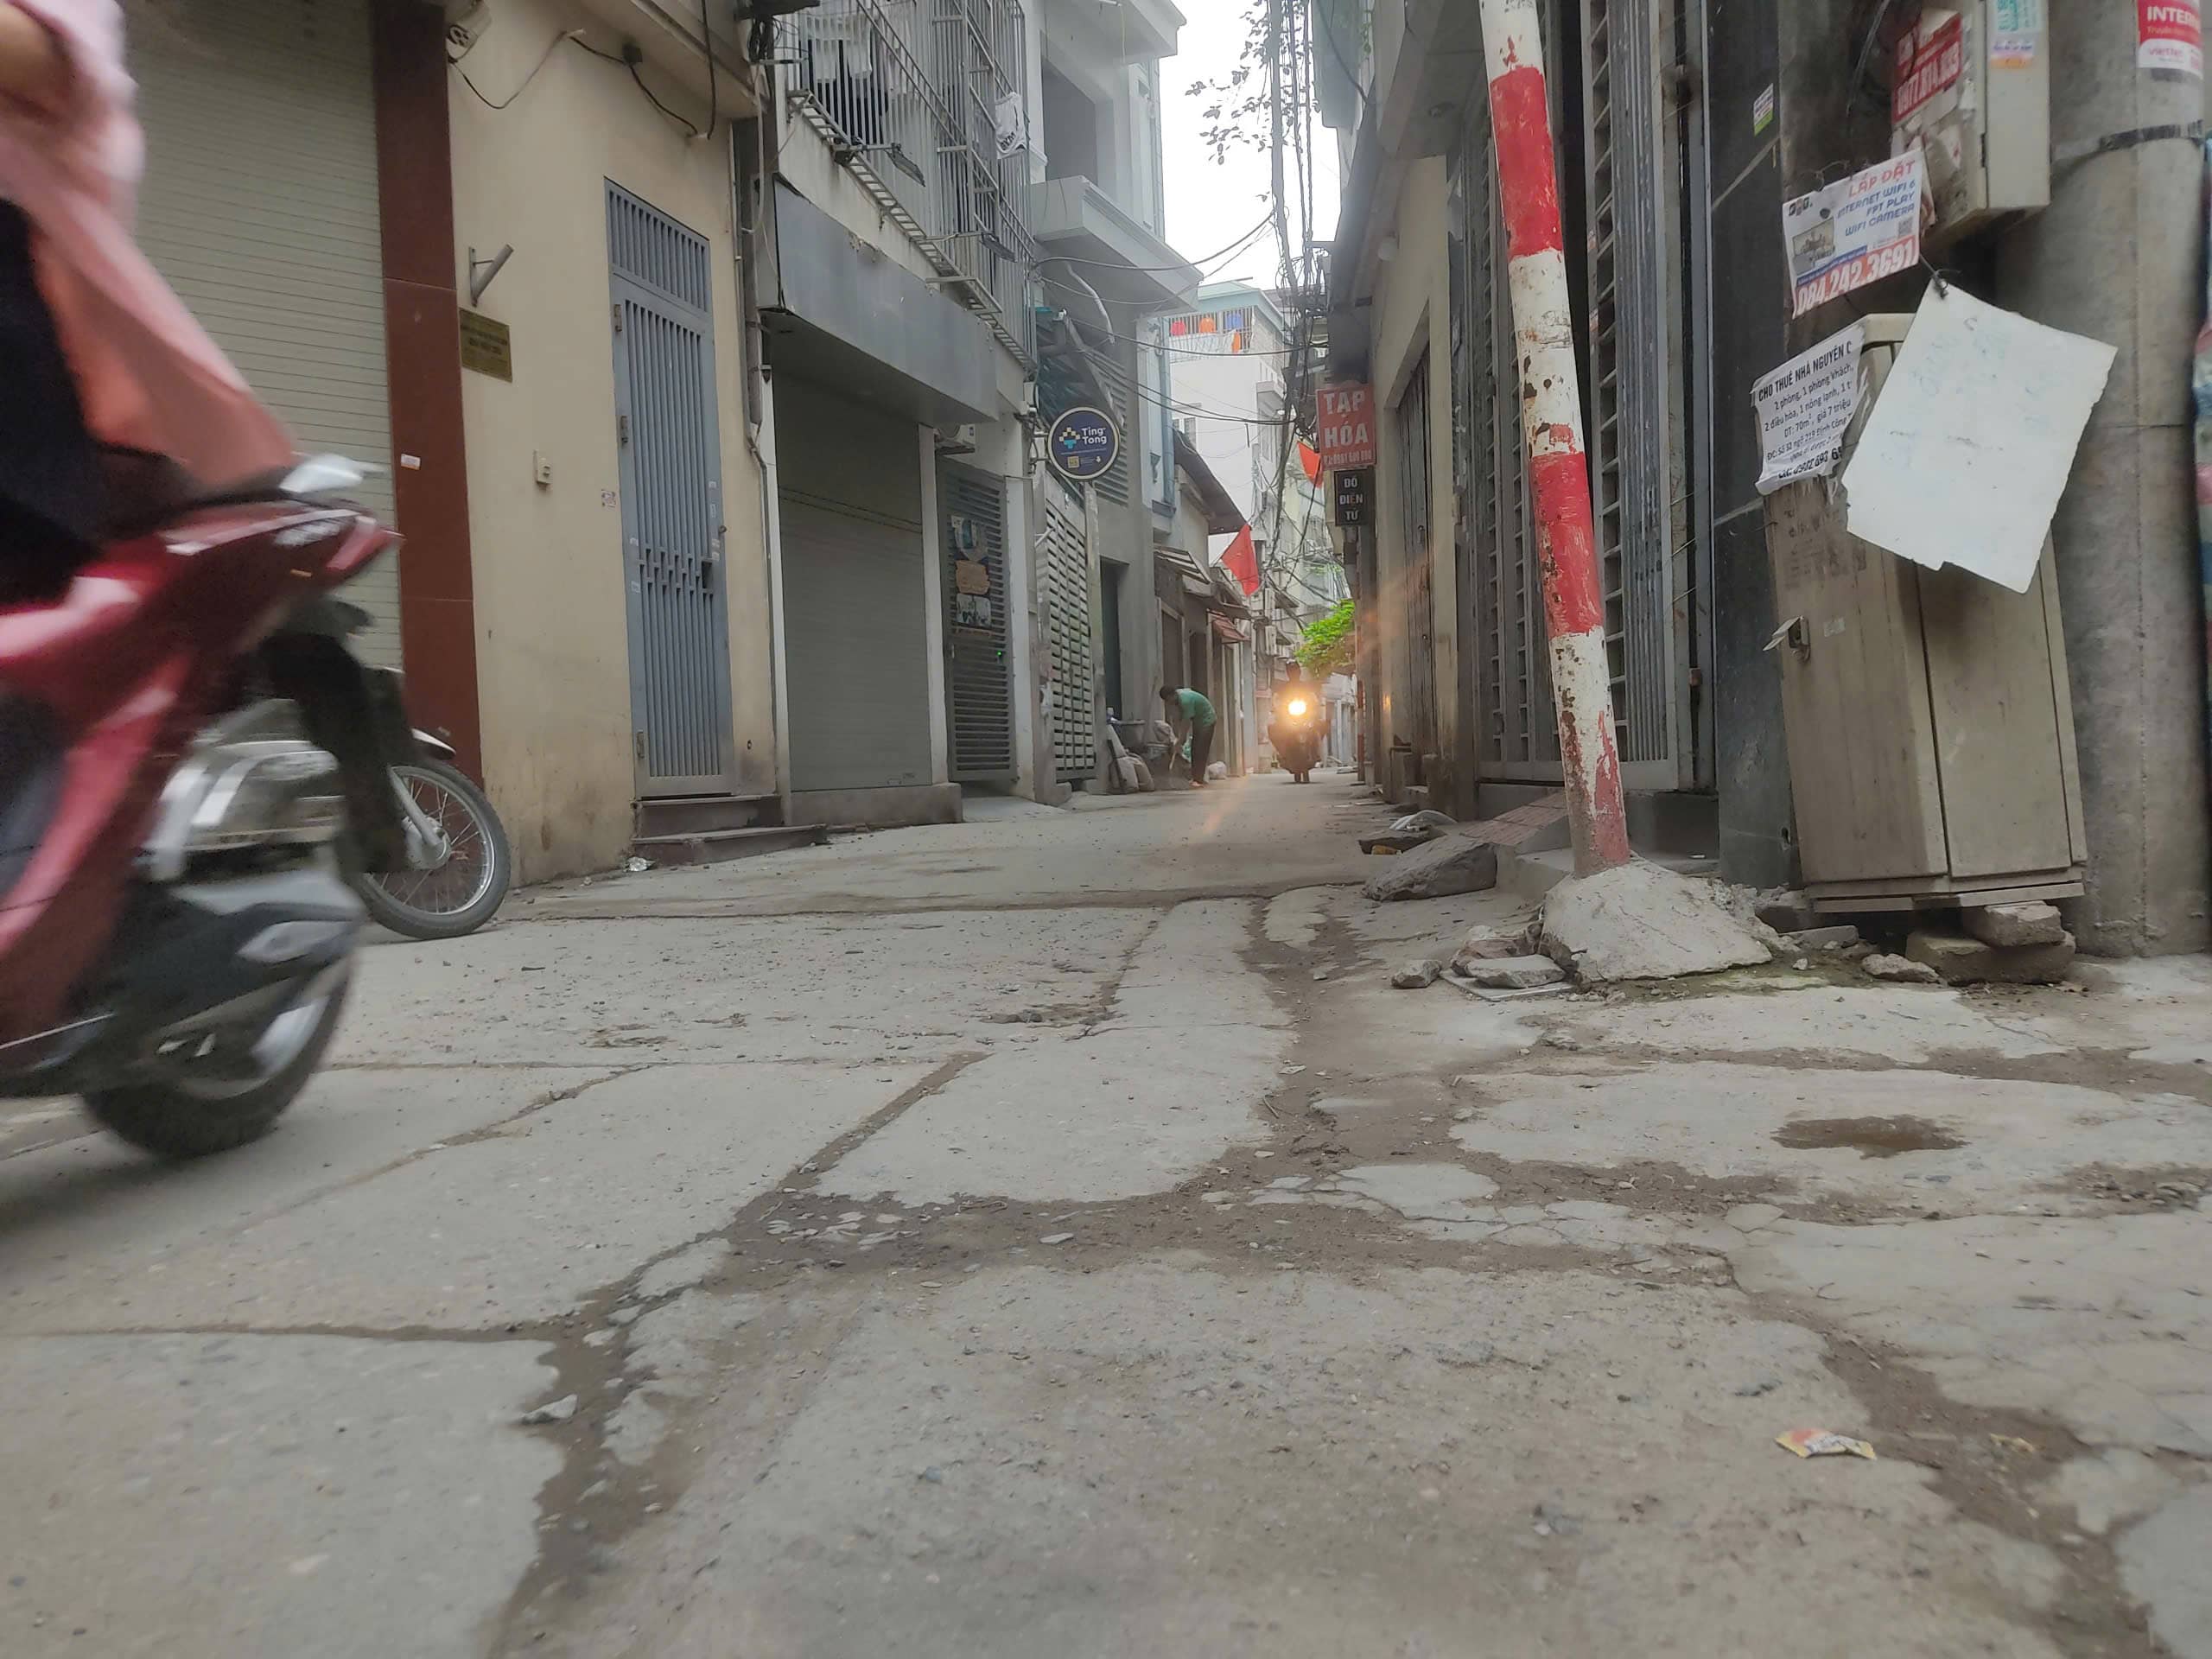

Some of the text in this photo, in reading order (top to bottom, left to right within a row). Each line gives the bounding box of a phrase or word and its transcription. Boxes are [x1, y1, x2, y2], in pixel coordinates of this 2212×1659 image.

[1836, 178, 1916, 219] INTERNET WIFI 6
[1866, 191, 1916, 217] FPT PLAY
[1845, 203, 1915, 237] WIFI CAMERA
[1796, 238, 1915, 316] 084.242.3691
[1758, 384, 1773, 402] CHO
[1775, 370, 1793, 393] THUÊ
[1813, 344, 1844, 373] NGUYÊN
[1324, 391, 1365, 418] TẠP
[1774, 401, 1779, 410] 2
[1802, 386, 1807, 396] 1
[1827, 406, 1833, 416] 7
[1081, 427, 1105, 436] Ting
[1764, 423, 1769, 432] 2
[1800, 404, 1803, 414] 1
[1081, 435, 1107, 445] Tong
[1325, 420, 1368, 448] HÓA
